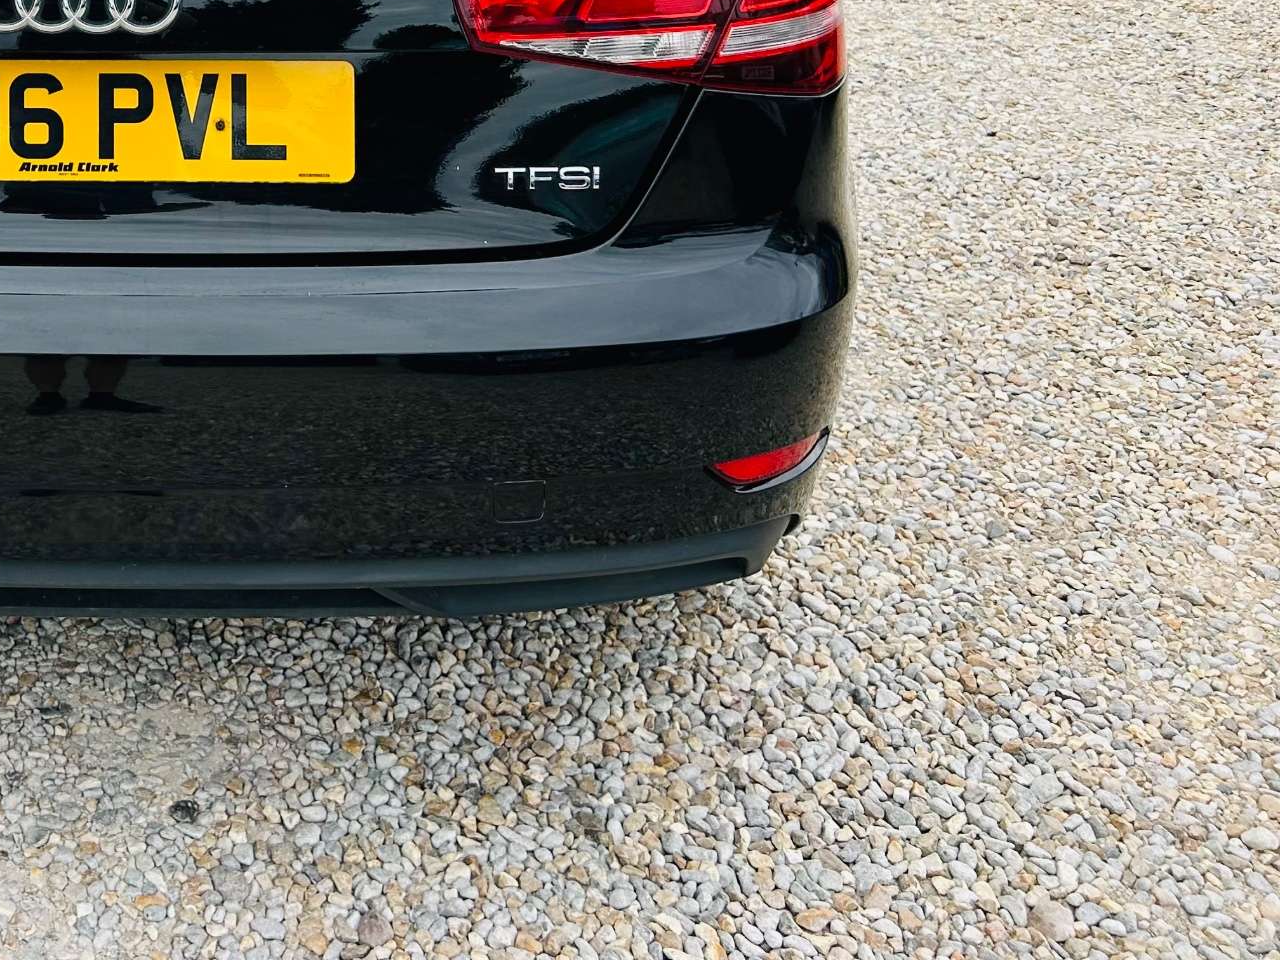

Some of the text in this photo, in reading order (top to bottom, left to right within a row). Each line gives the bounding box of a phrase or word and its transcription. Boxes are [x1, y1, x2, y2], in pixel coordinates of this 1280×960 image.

[98, 72, 288, 161] PVL
[18, 162, 120, 172] Arnold Clark
[494, 166, 601, 190] TFSI
